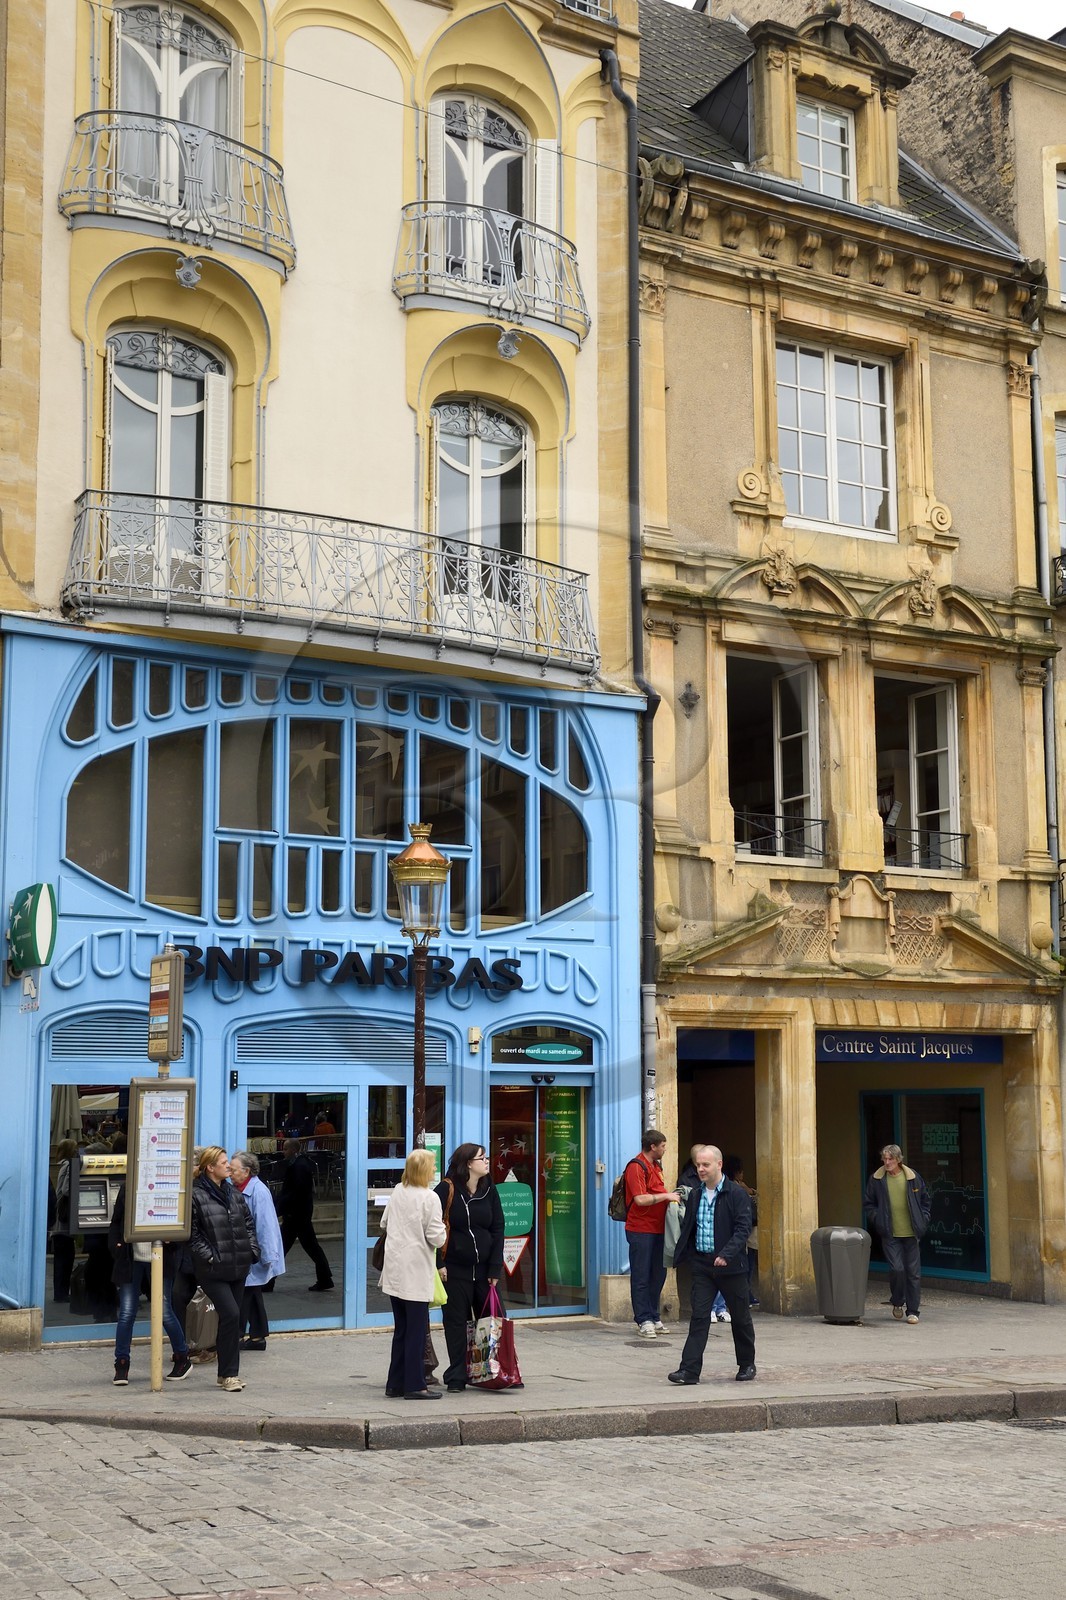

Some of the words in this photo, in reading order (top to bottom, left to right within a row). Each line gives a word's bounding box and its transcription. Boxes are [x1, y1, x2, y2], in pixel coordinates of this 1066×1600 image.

[175, 945, 284, 983] BNP
[301, 949, 524, 991] PARIBAS
[822, 1034, 875, 1054] Centre
[879, 1035, 917, 1055] Saint
[920, 1036, 974, 1059] Jacques
